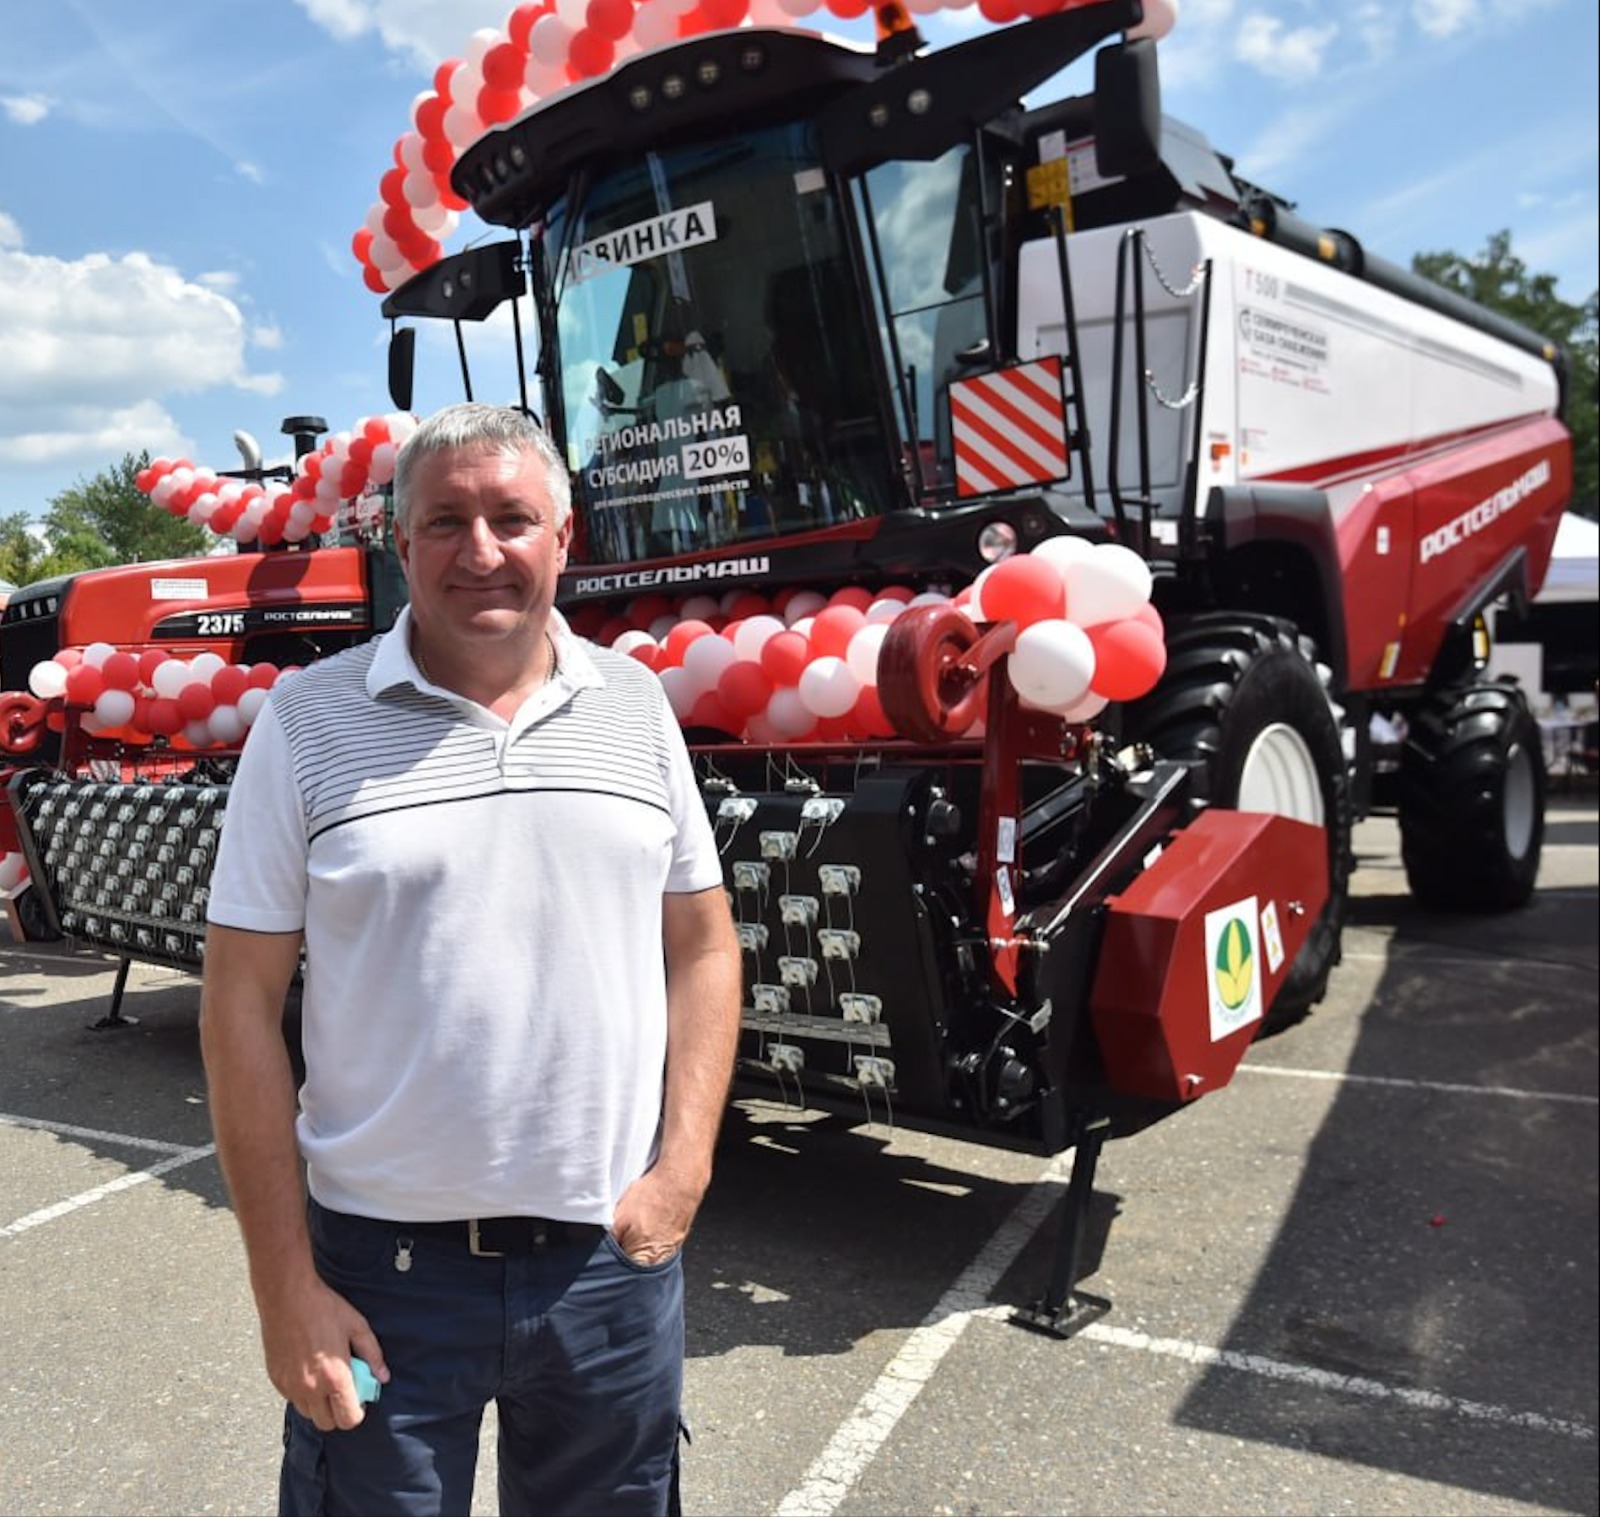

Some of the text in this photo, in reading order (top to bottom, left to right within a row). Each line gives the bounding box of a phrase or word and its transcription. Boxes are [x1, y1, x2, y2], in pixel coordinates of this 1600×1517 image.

[567, 212, 706, 281] ОВИНКА
[585, 405, 742, 456] РЕГИОНАЛЬНАЯ
[588, 442, 744, 489] СУБСИДИЯ 20%
[576, 556, 769, 594] РОСТСЕЛЬМАШ
[198, 613, 245, 635] 2375
